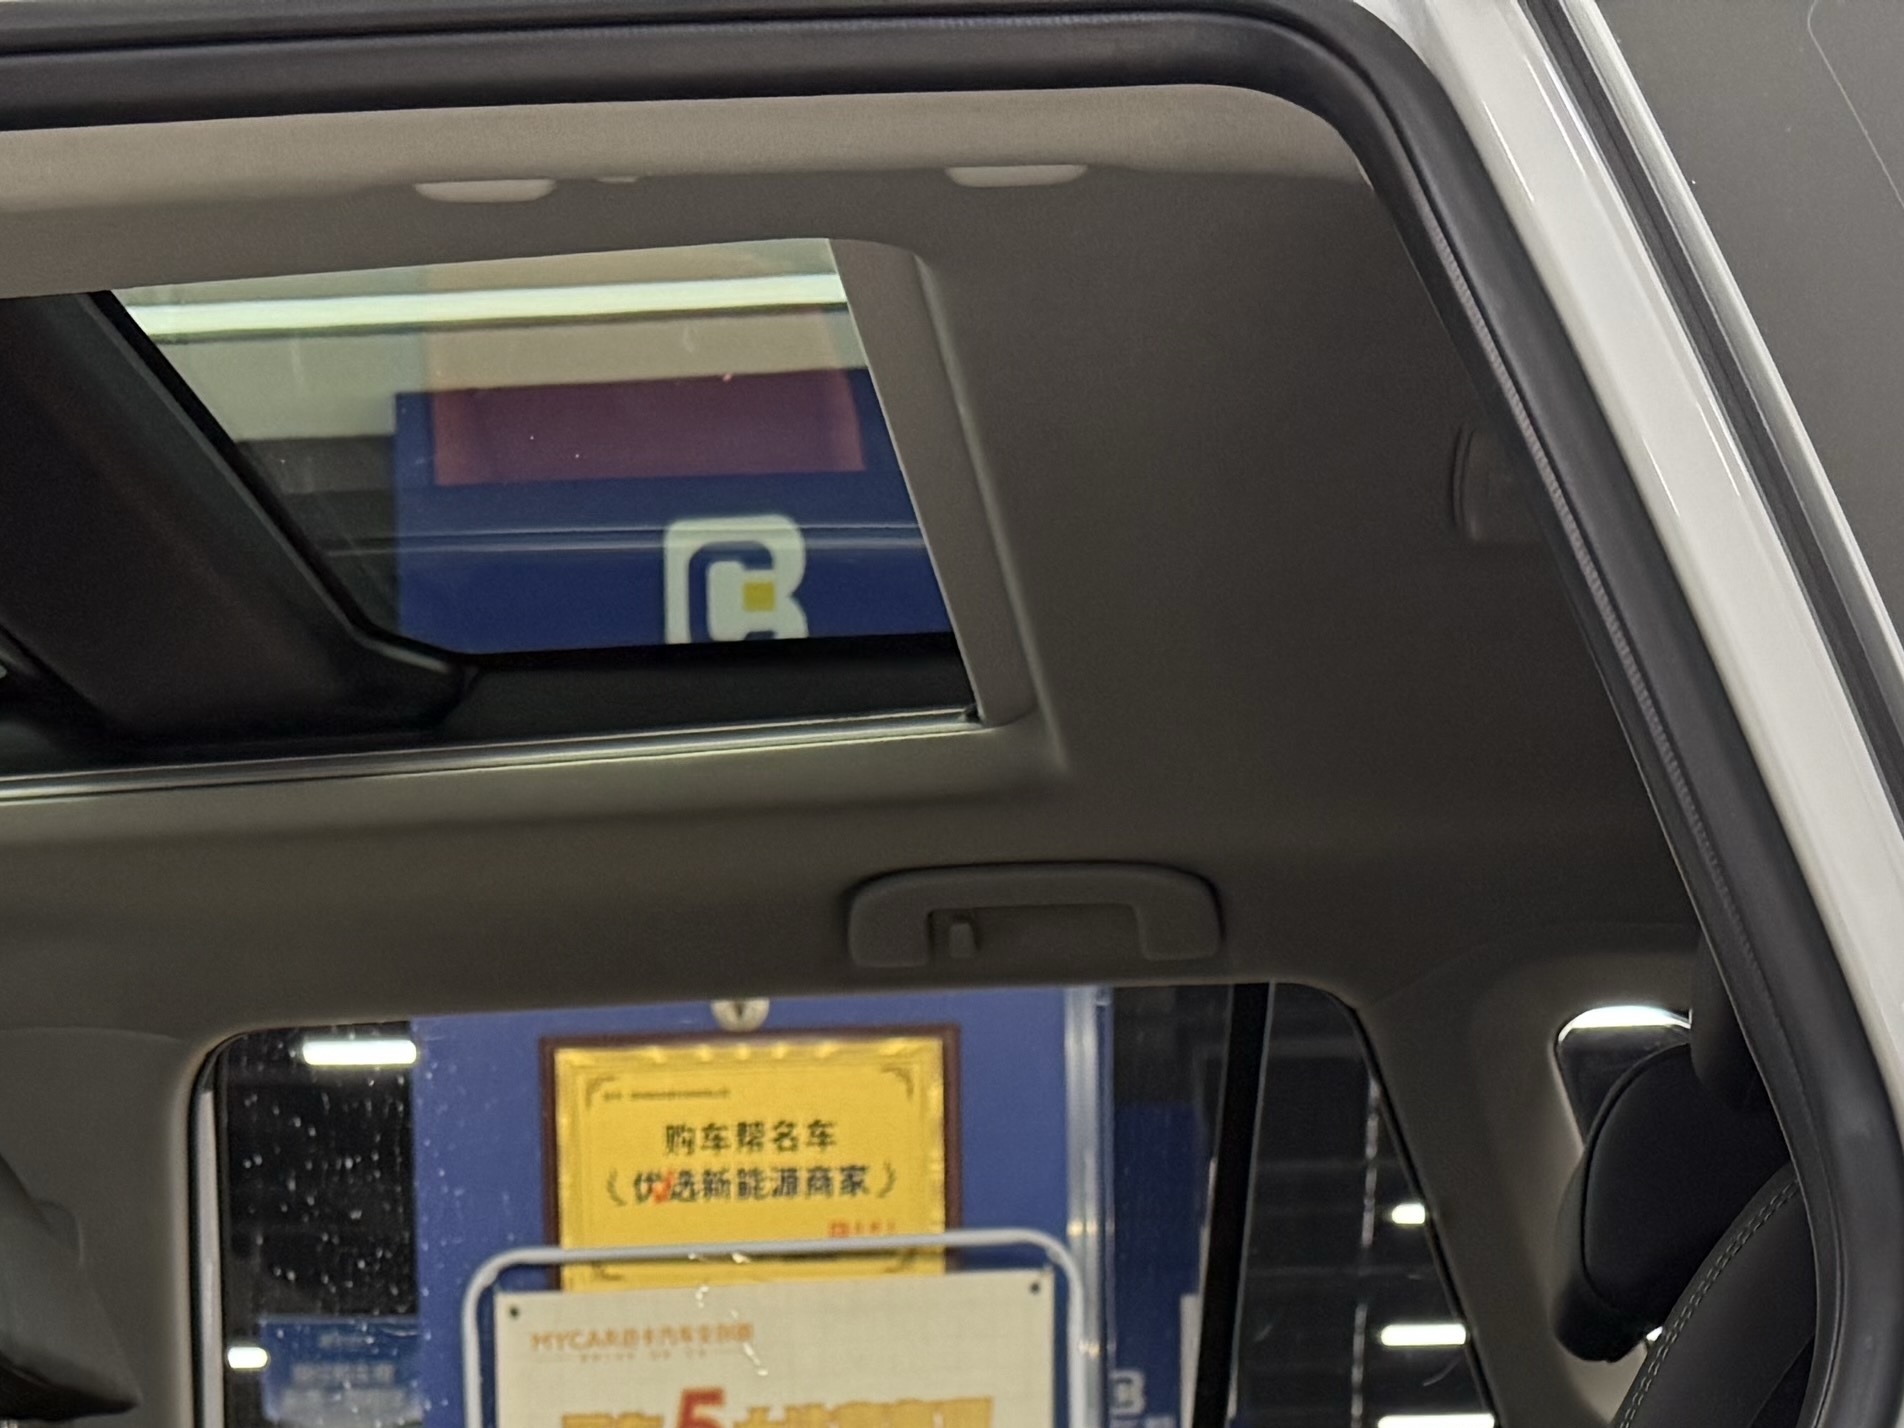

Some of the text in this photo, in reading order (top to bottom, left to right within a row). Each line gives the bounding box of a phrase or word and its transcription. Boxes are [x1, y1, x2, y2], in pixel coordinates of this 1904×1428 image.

[664, 1119, 838, 1156] 购车帮名车
